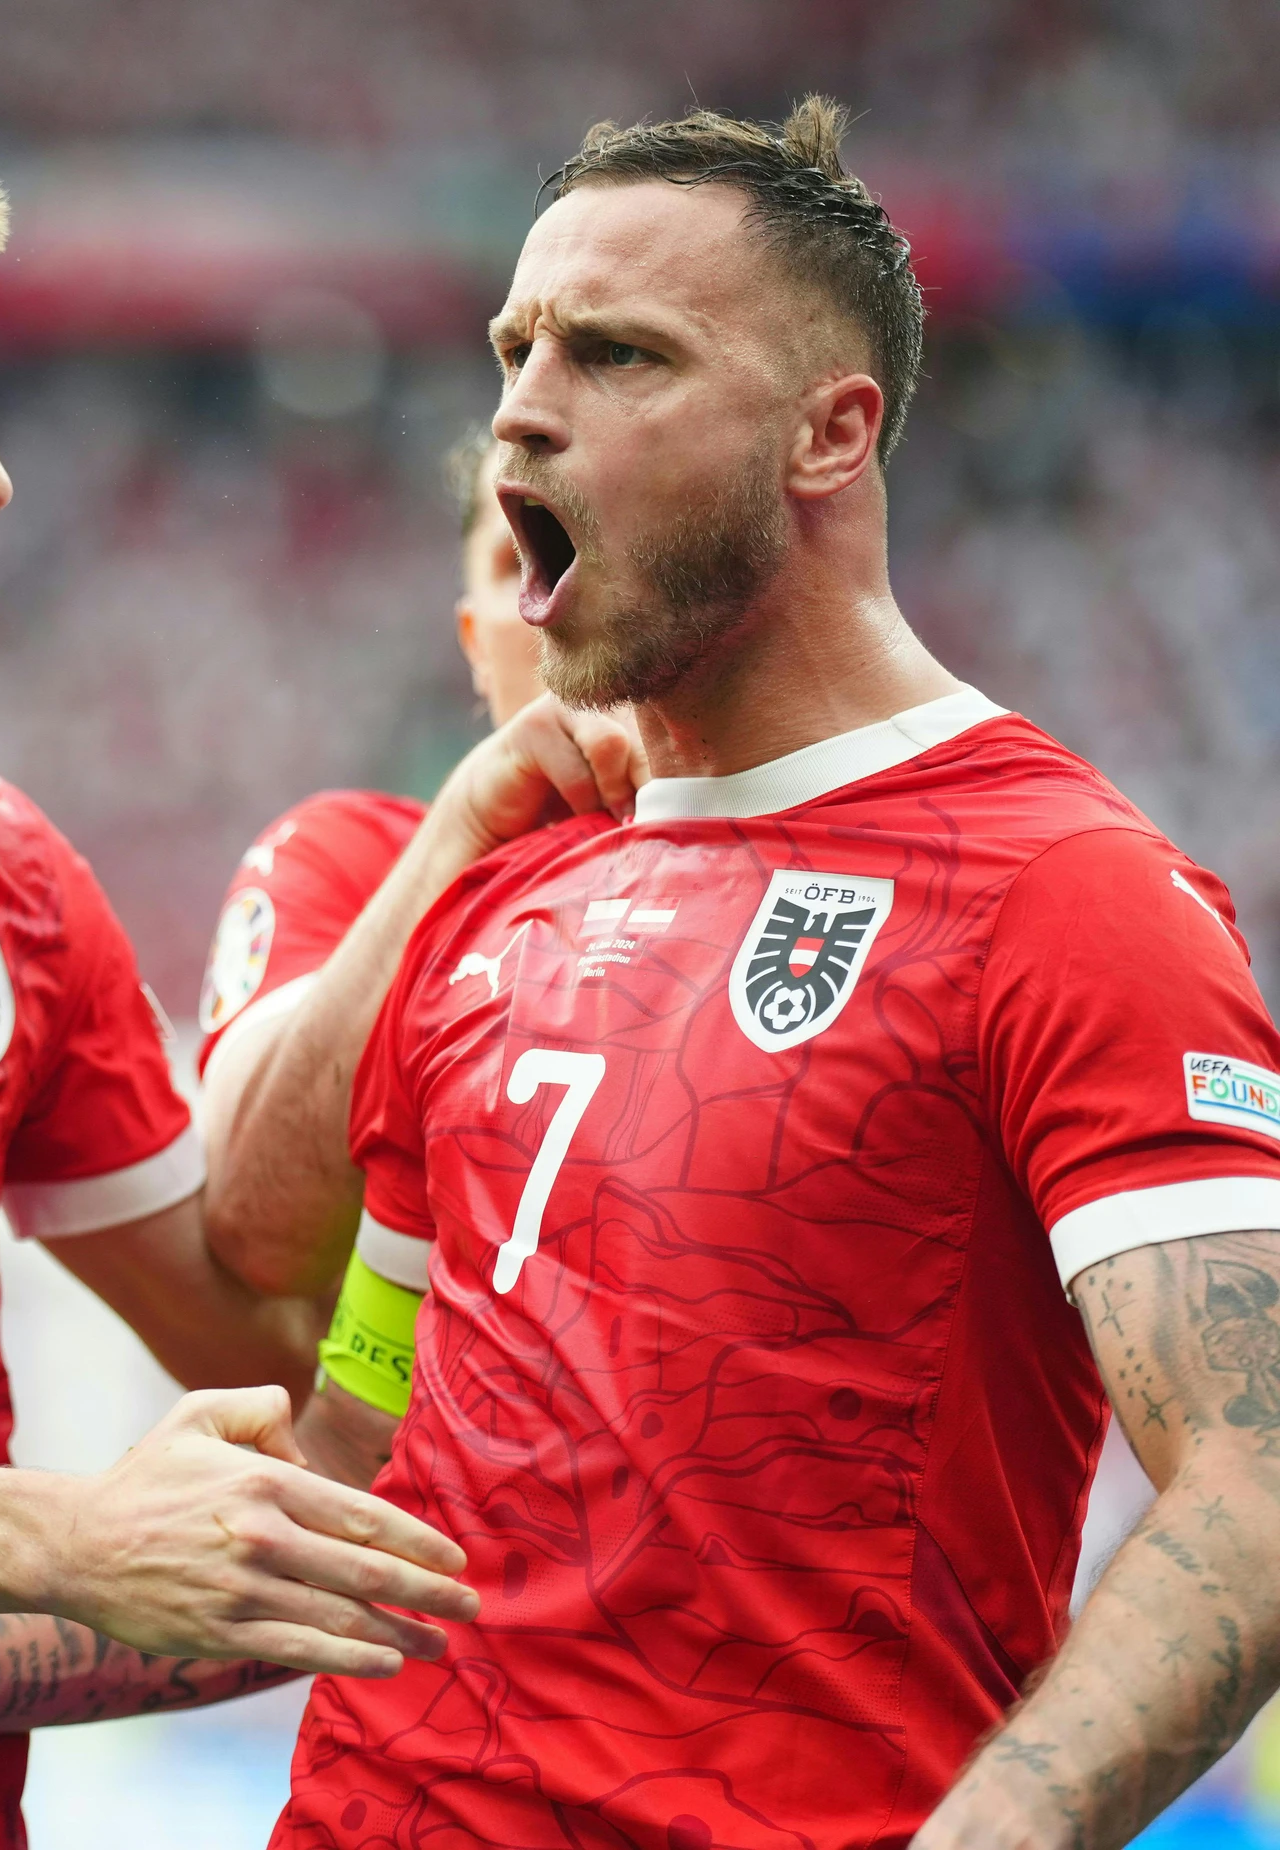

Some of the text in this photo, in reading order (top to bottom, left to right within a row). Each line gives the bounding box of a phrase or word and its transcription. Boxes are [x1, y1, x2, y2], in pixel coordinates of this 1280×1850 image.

[785, 882, 876, 904] SEIT ÖFB 1904
[613, 939, 636, 950] 2024
[583, 967, 606, 977] Berlin
[1190, 1057, 1232, 1075] UEFA
[1191, 1074, 1280, 1115] FOUND
[492, 1047, 607, 1295] 7
